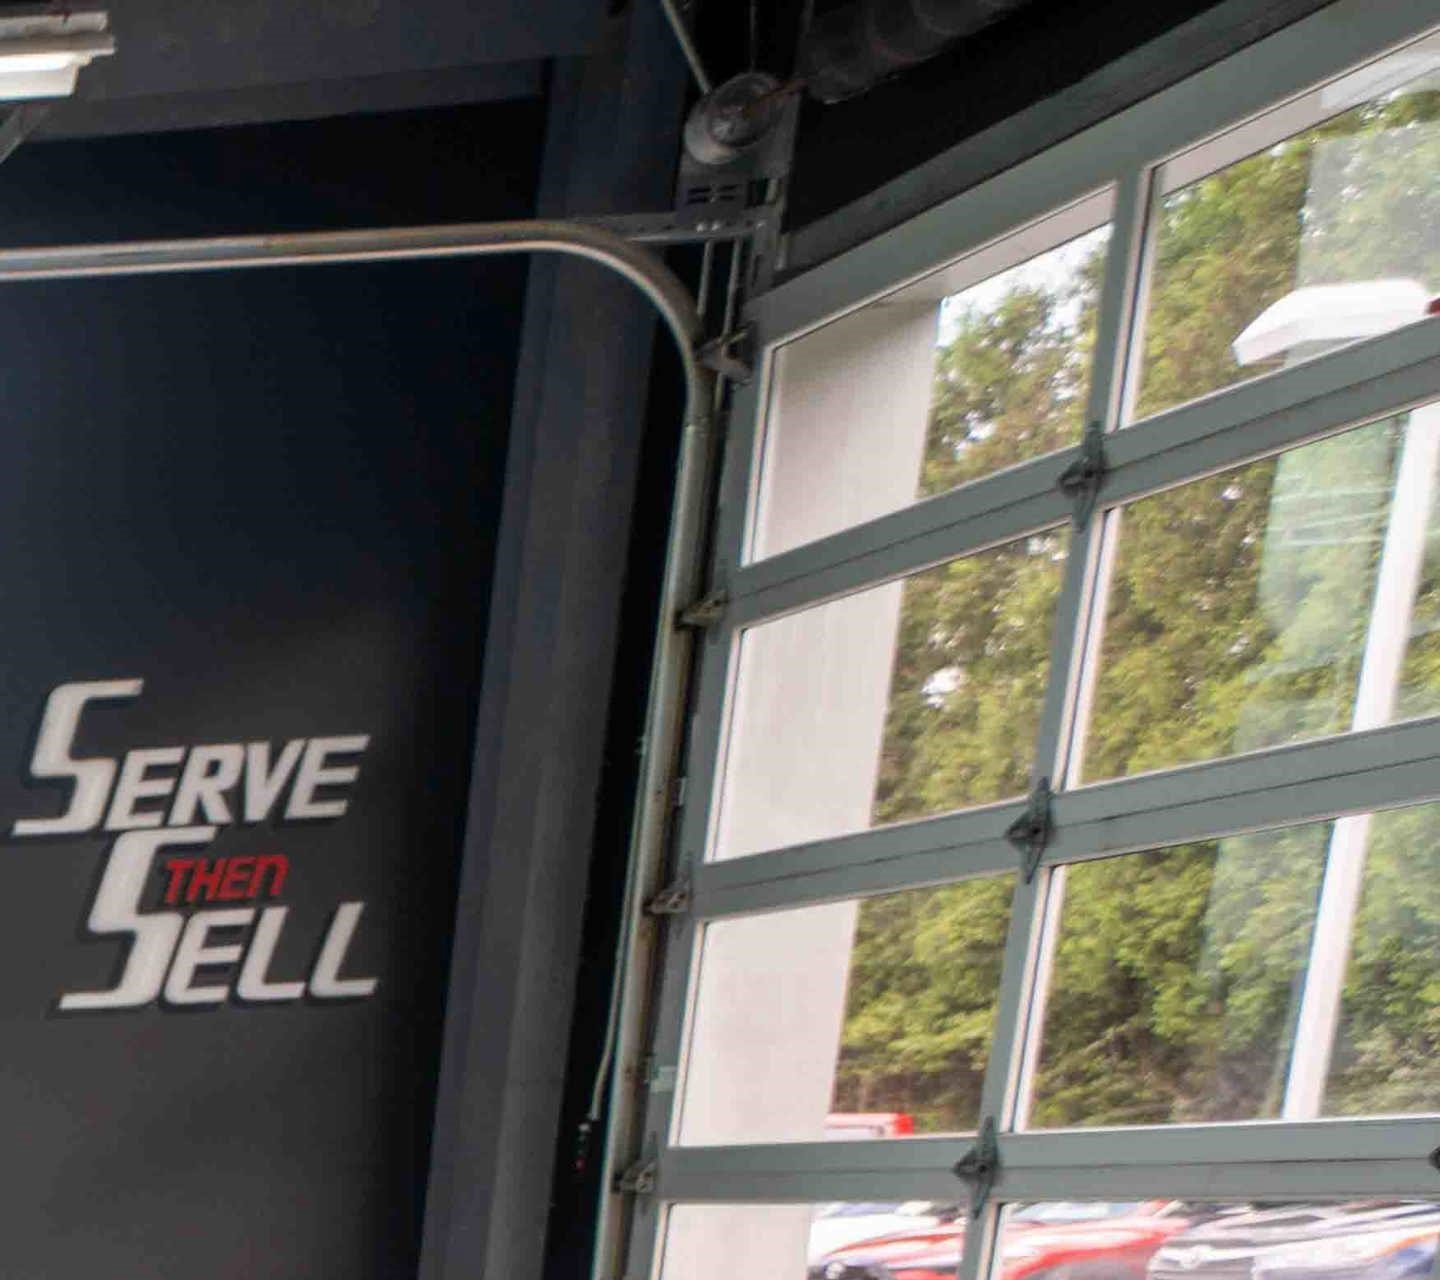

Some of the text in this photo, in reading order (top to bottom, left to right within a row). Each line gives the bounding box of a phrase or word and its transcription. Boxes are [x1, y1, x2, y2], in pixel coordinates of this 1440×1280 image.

[11, 678, 371, 836] SERVE
[58, 825, 379, 1010] SELL
[165, 853, 289, 902] THEN
